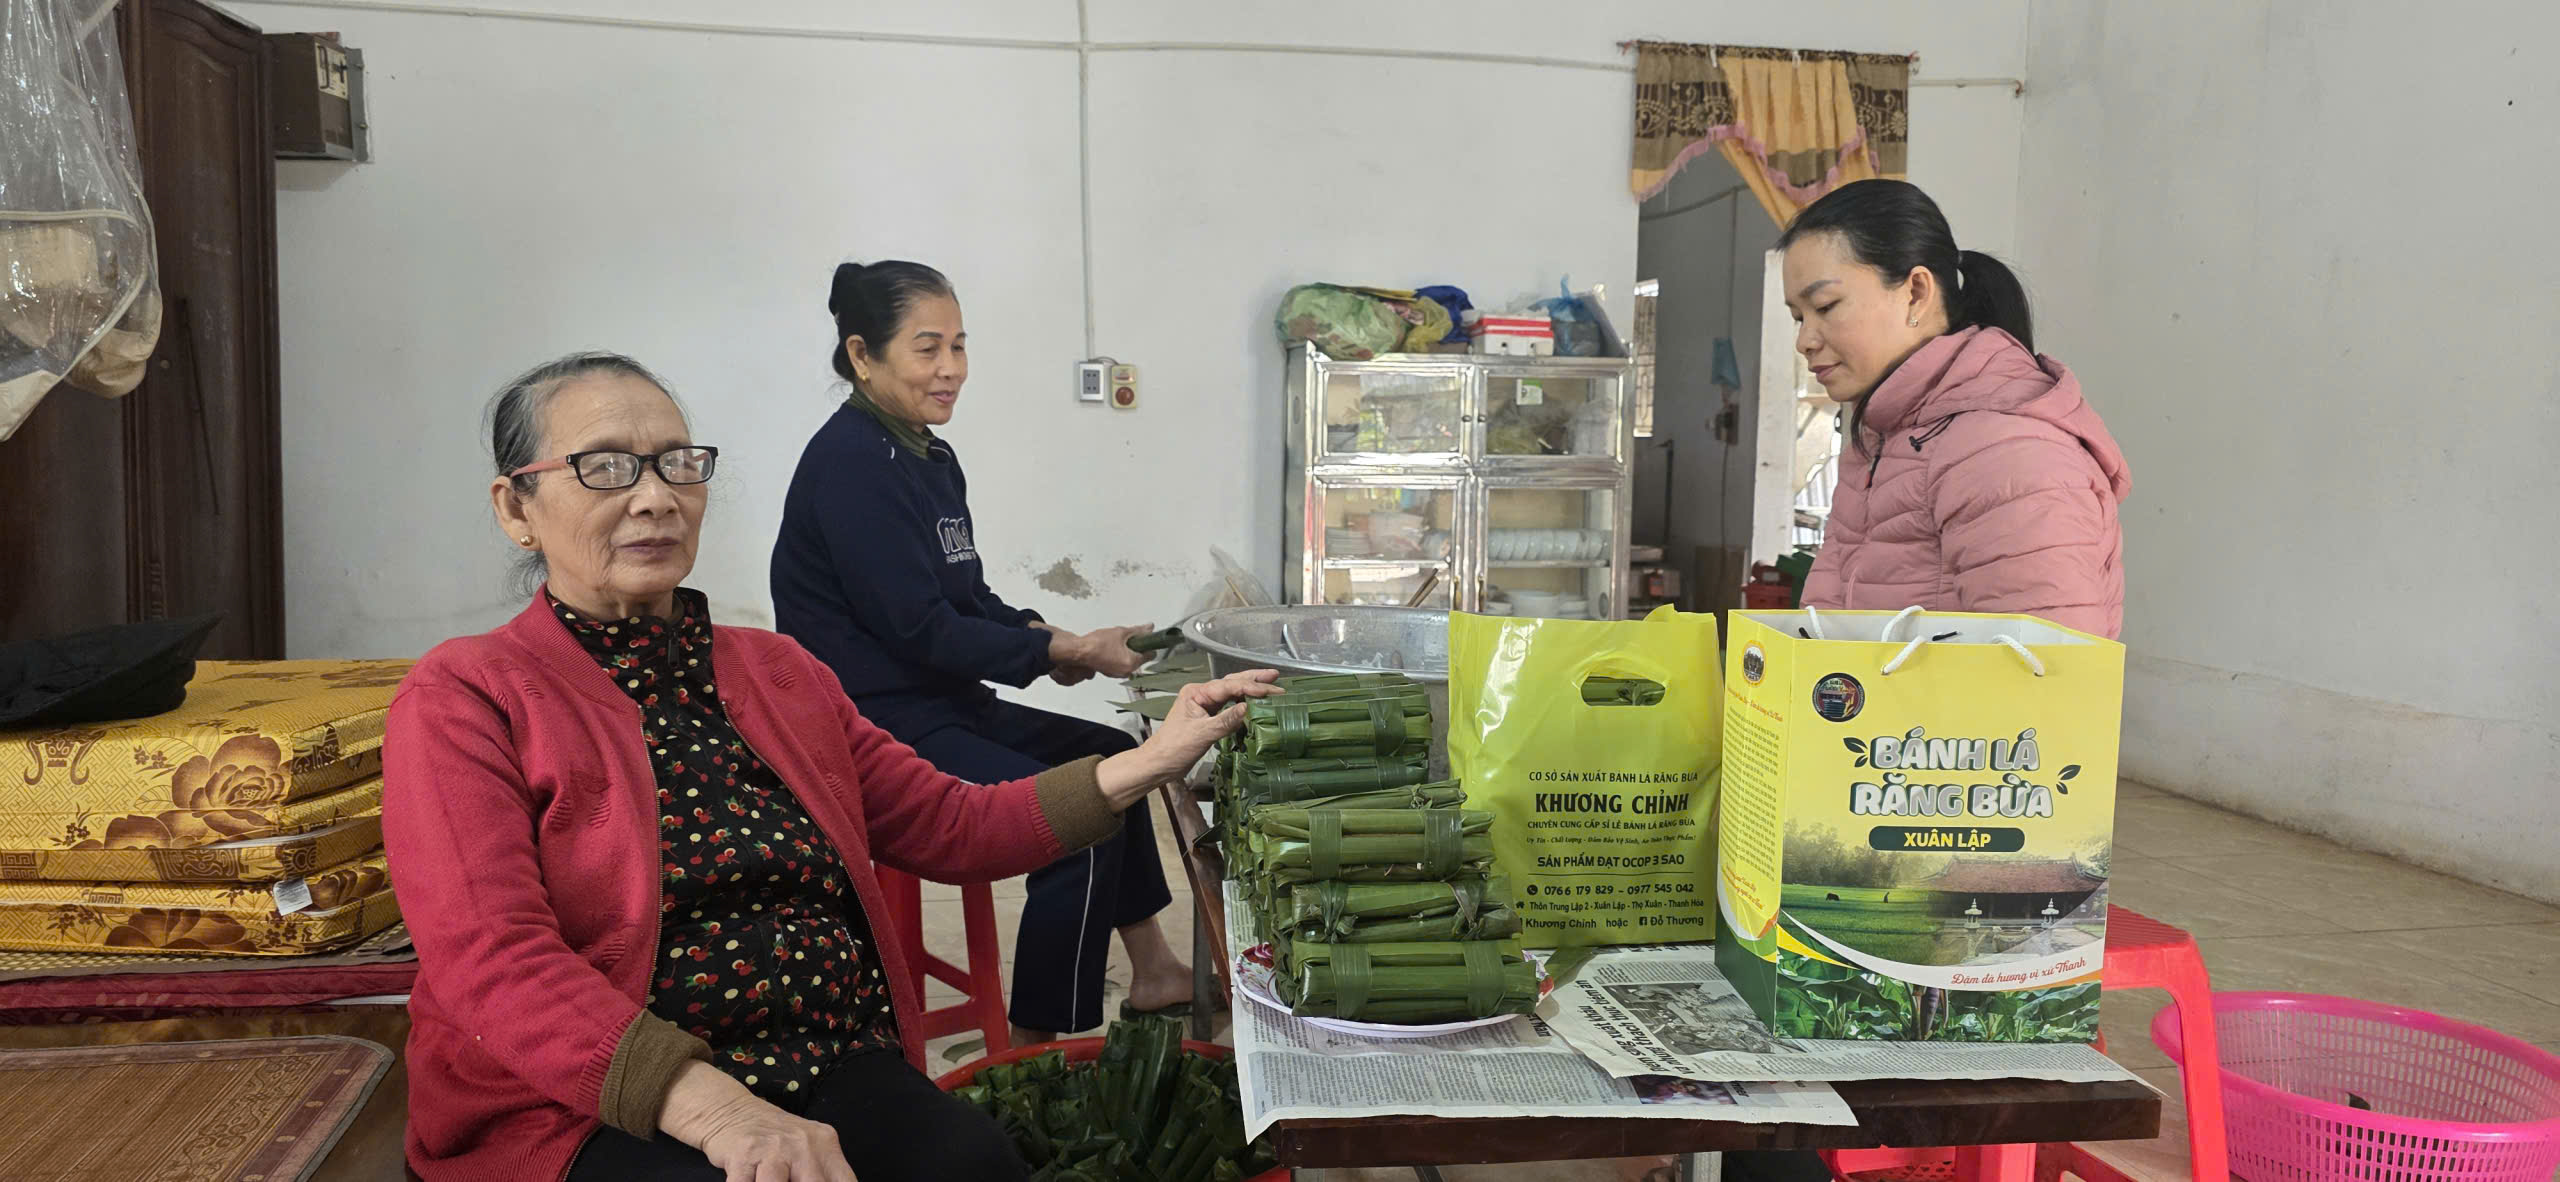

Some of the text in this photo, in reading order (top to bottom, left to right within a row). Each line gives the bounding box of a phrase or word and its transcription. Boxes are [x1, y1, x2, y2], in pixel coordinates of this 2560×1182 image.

[1869, 725, 2041, 772] BÁNH LÁ
[1535, 789, 1690, 814] KHƯƠNG CHỈNH
[1850, 772, 2054, 818] RĂNG BỪA
[1560, 820, 1582, 829] CUNG
[1904, 829, 1991, 851] XUÂN LẬP
[1563, 851, 1594, 867] PHẨM
[1597, 855, 1620, 869] ĐẠT
[1622, 855, 1651, 868] OCOP
[1652, 855, 1659, 865] 3
[1661, 854, 1685, 865] SAO
[1544, 886, 1571, 896] 0766
[1575, 886, 1591, 896] 179
[1595, 885, 1614, 895] 829
[1627, 884, 1650, 895] 0977
[1654, 883, 1672, 894] 545
[1676, 883, 1694, 893] 042
[1549, 901, 1569, 913] Trung
[1584, 902, 1590, 910] 2
[1668, 899, 1690, 909] Thanh
[1526, 917, 1566, 930] Khương
[1605, 916, 1629, 929] hoặc
[1667, 914, 1704, 927] Thương
[2029, 969, 2039, 980] vị
[2055, 957, 2087, 974] Thanh
